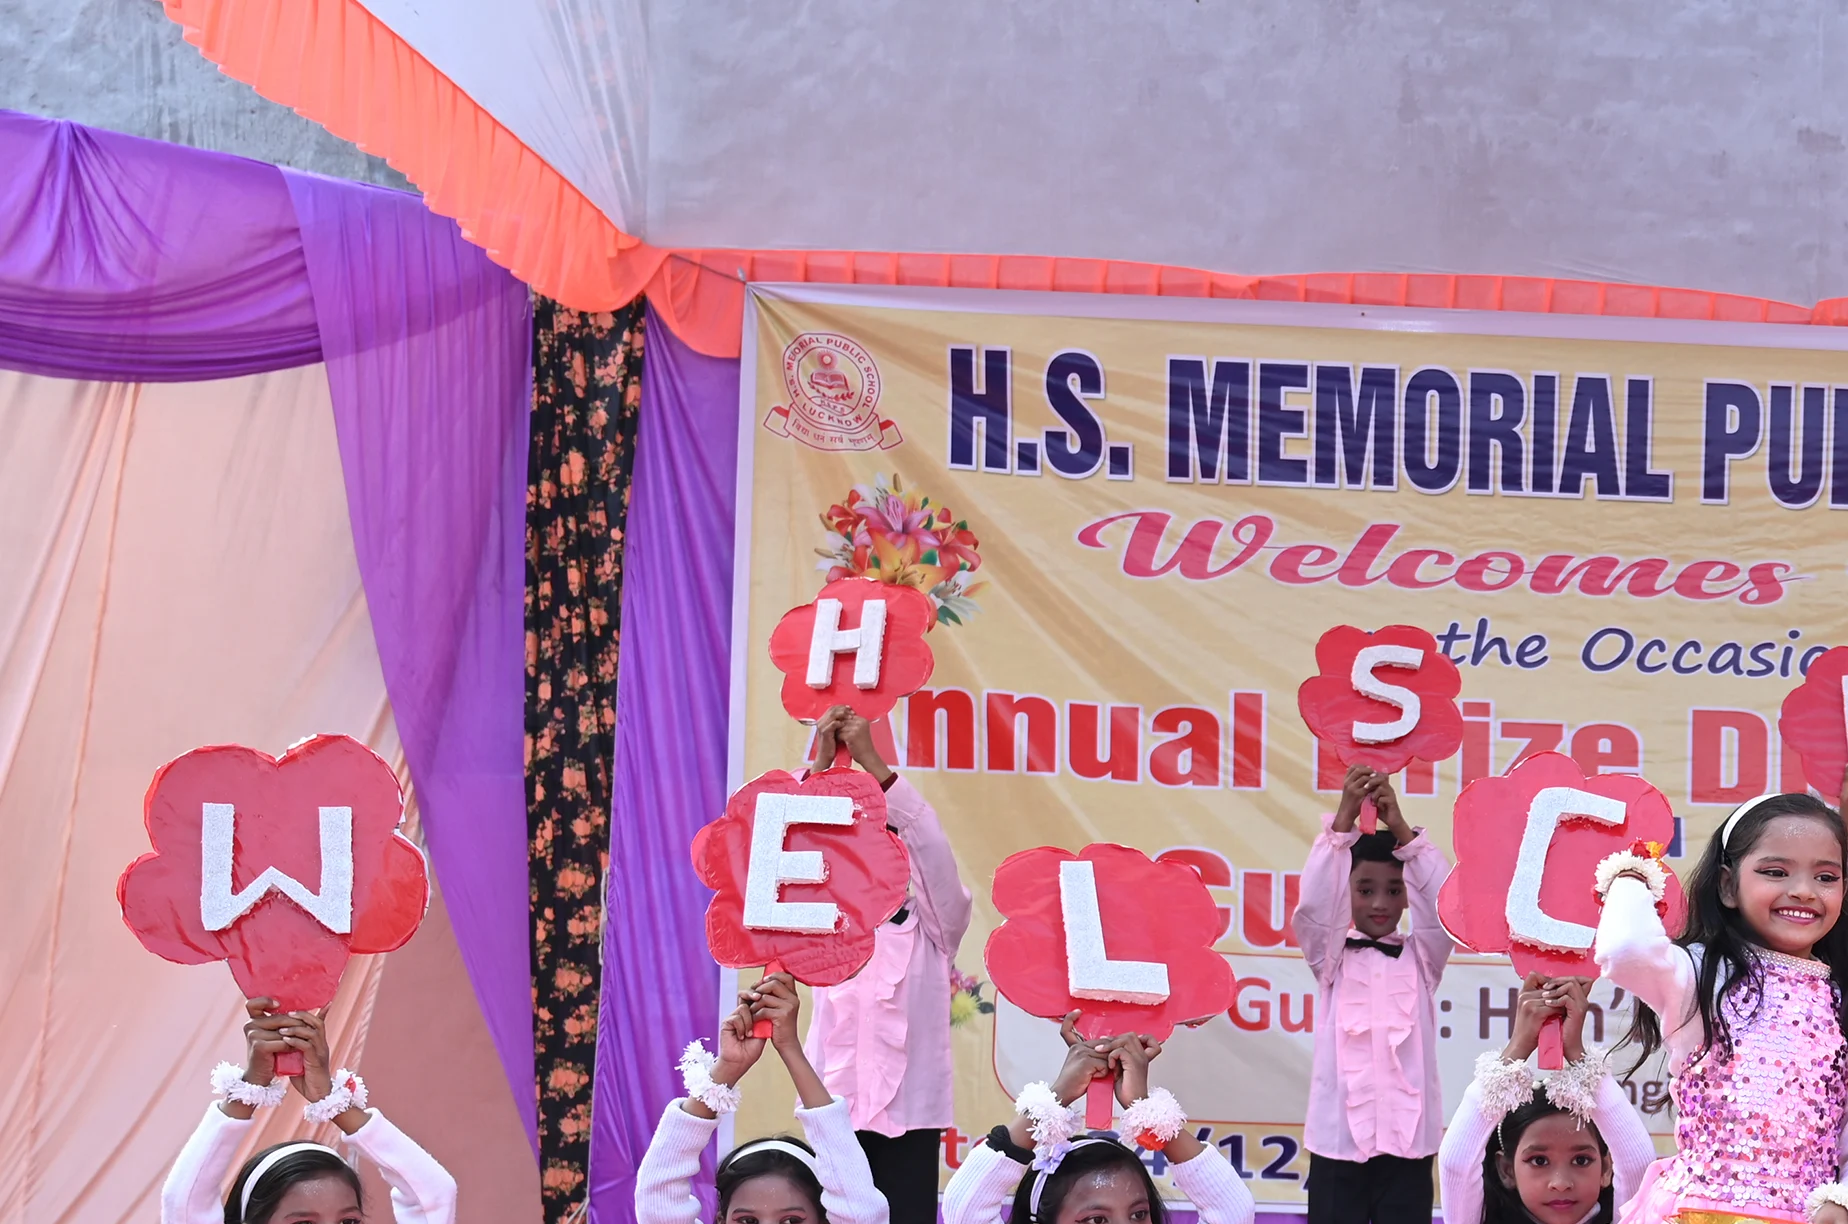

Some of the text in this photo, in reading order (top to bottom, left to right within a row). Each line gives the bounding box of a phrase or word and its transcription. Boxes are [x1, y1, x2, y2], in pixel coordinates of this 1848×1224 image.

[801, 402, 864, 428] LUCKNOW
[827, 338, 867, 364] PUBLIC
[862, 366, 876, 408] SCHOOL
[949, 347, 1130, 476] H.S.
[1167, 358, 1671, 499] MEMORIAL
[1078, 511, 1806, 605] Welcomes
[805, 599, 887, 689] H
[1436, 618, 1549, 669] the
[1351, 645, 1425, 744] S
[1317, 700, 1640, 797] ize
[202, 803, 352, 934] W
[743, 792, 860, 934] E
[1505, 787, 1626, 955] C
[1059, 860, 1170, 1005] L
